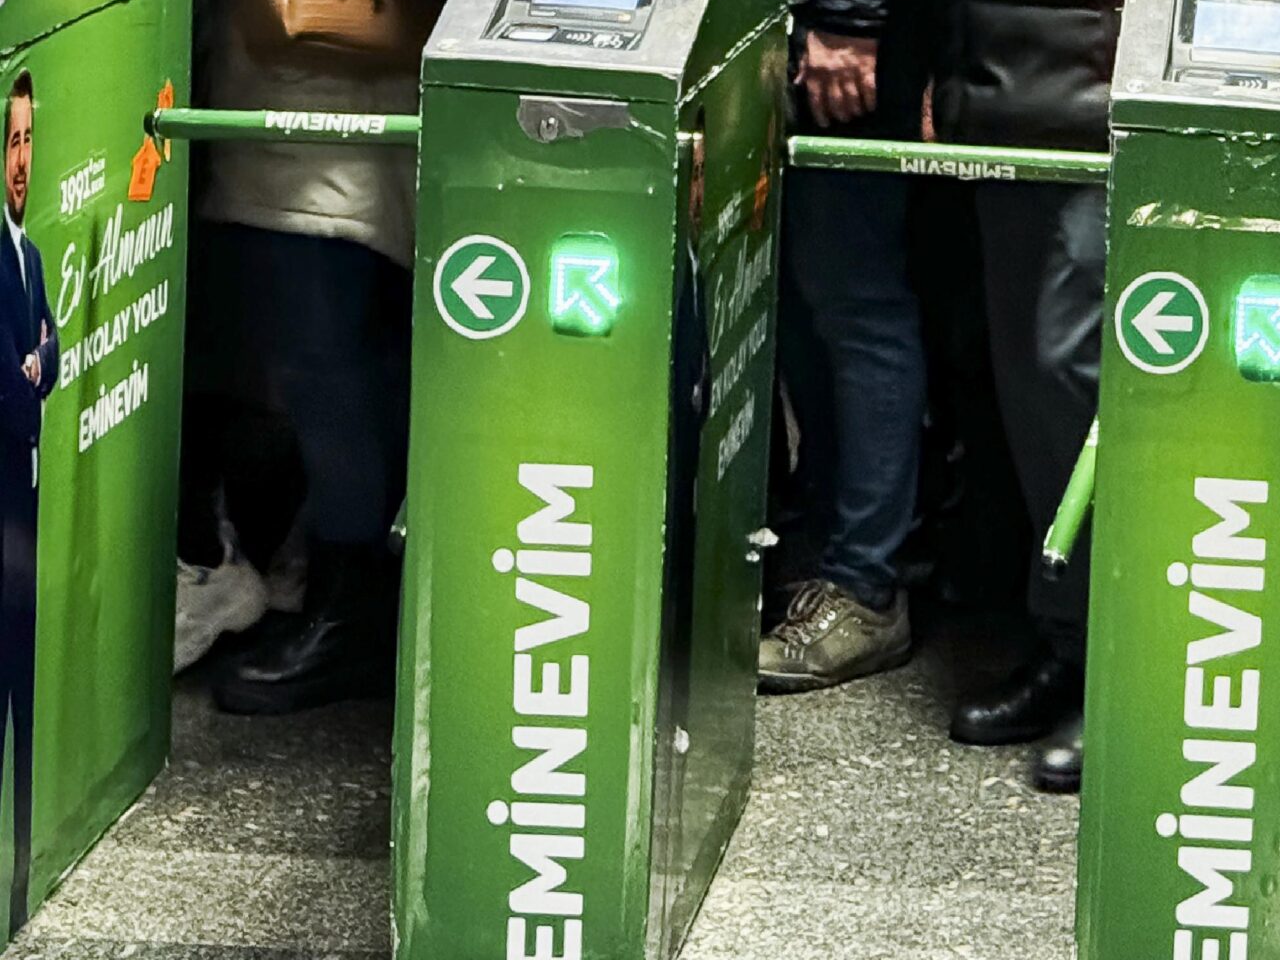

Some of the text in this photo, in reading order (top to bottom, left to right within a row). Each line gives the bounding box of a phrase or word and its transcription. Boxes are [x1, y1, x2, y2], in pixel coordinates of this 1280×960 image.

[56, 242, 87, 328] Ev
[60, 279, 169, 389] EN KOLAY YOLU
[79, 359, 149, 453] EMİNEVİM
